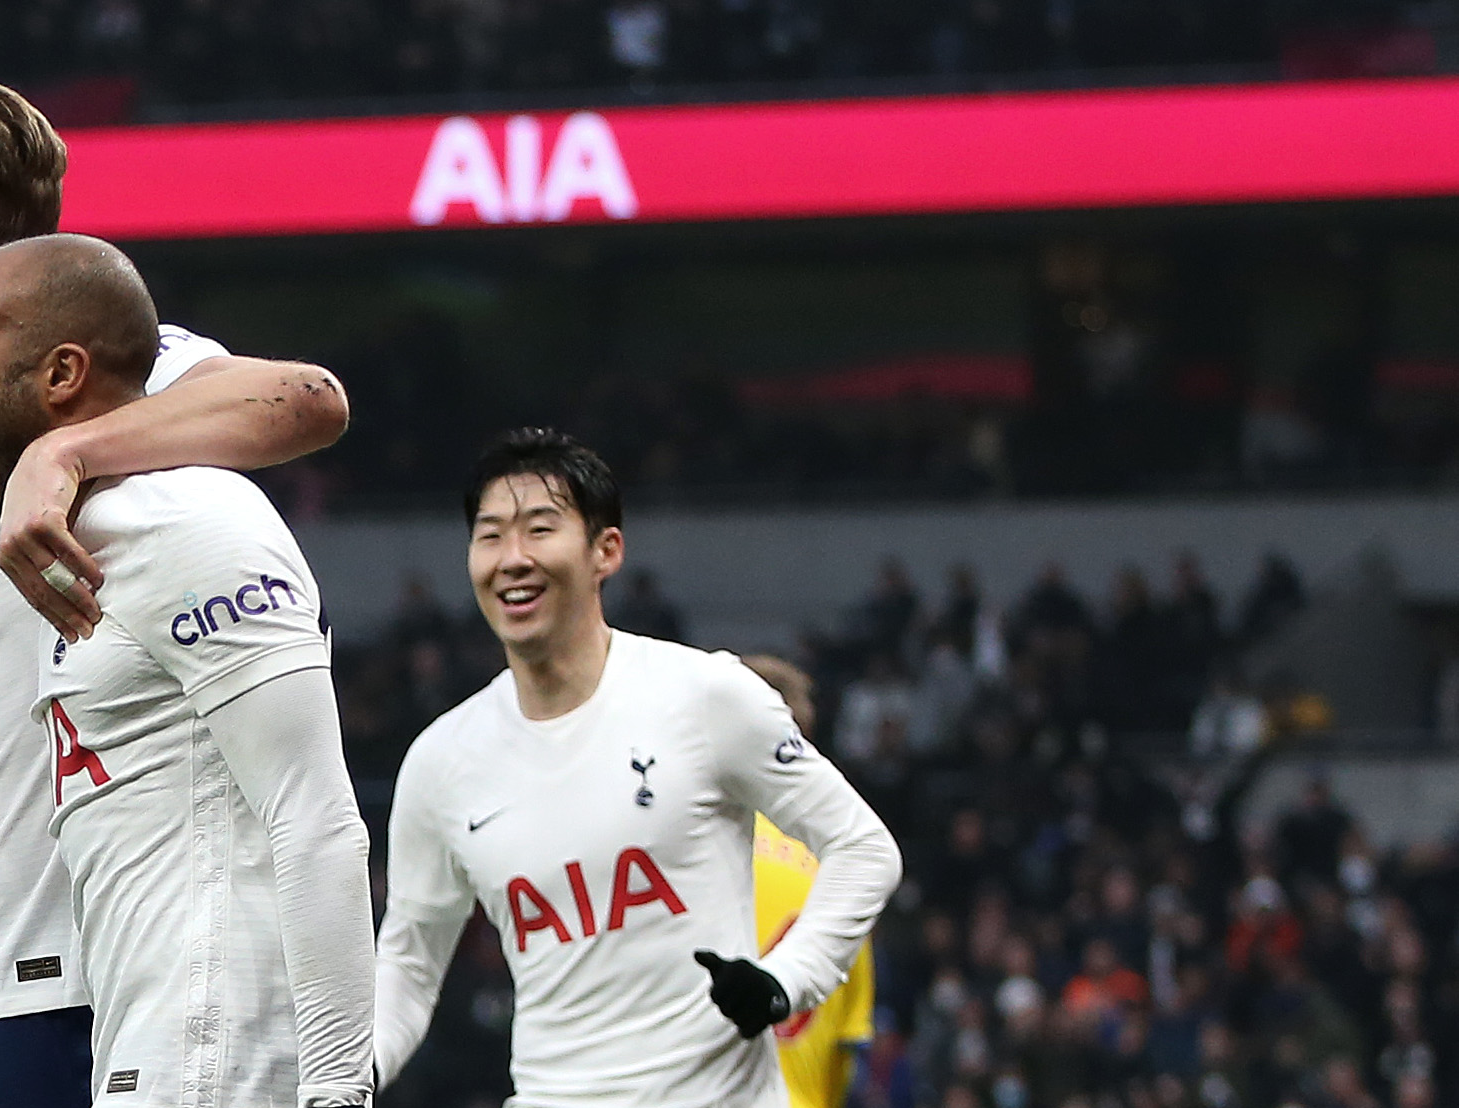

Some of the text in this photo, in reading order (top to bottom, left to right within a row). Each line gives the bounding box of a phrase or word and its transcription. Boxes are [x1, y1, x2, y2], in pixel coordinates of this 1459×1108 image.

[408, 111, 640, 226] AIA
[171, 574, 298, 646] cinch
[505, 847, 689, 953] AIA
